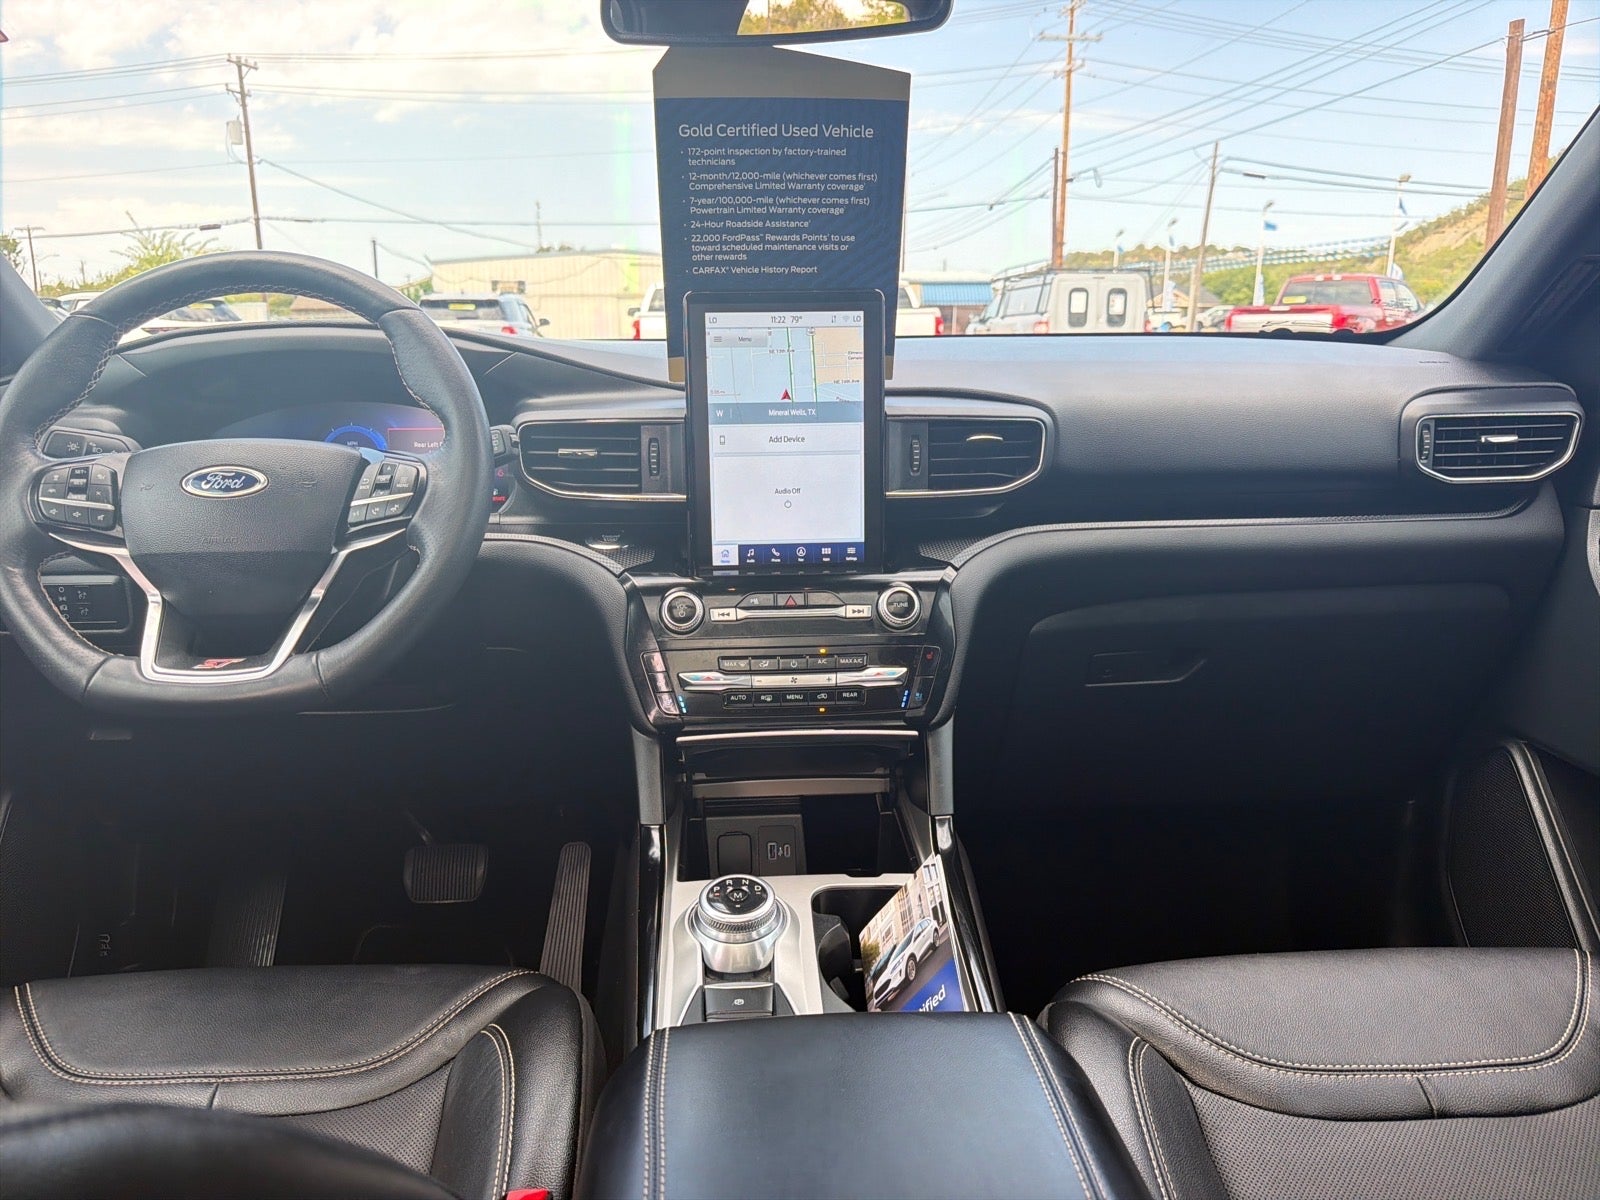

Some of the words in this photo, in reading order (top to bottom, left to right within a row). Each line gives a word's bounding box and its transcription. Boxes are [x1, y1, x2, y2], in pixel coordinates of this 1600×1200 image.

[678, 123, 713, 137] Gold
[716, 123, 778, 137] Certified
[781, 123, 818, 137] Used
[822, 123, 874, 138] Vehicle
[687, 147, 726, 156] 172-point
[727, 147, 771, 156] inspection
[772, 147, 782, 156] by
[783, 146, 847, 157] factory-trained
[688, 157, 736, 166] technicians
[688, 171, 781, 181] 12-month/12,000-mile
[782, 171, 827, 181] (whichever
[858, 172, 878, 182] first)
[688, 182, 753, 191] Comprehensive
[754, 181, 786, 190] Limited
[787, 182, 825, 191] Warranty
[689, 195, 774, 206] 7-year/100,000-mile
[775, 196, 820, 205] (whichever
[821, 197, 849, 205] comes
[850, 196, 870, 206] first)
[690, 206, 735, 214] Powertrain
[736, 206, 767, 214] Limited
[768, 206, 806, 215] Warranty
[690, 220, 724, 229] 24-Hour
[725, 220, 763, 228] Roadside
[691, 234, 720, 242] 22,000
[765, 233, 801, 241] Rewards
[691, 243, 720, 252] toward
[722, 243, 763, 251] scheduled
[764, 243, 816, 251] maintenance
[817, 243, 839, 251] visits
[691, 253, 713, 261] other
[714, 253, 747, 261] rewards
[730, 266, 760, 274] Vehicle
[760, 265, 789, 274] History
[790, 265, 818, 274] Report
[708, 316, 718, 324] LO
[770, 316, 786, 324] 11:22
[852, 315, 862, 323] LO
[716, 409, 724, 417] W
[768, 435, 782, 443] Add
[783, 435, 806, 443] Device
[200, 471, 246, 490] Ford
